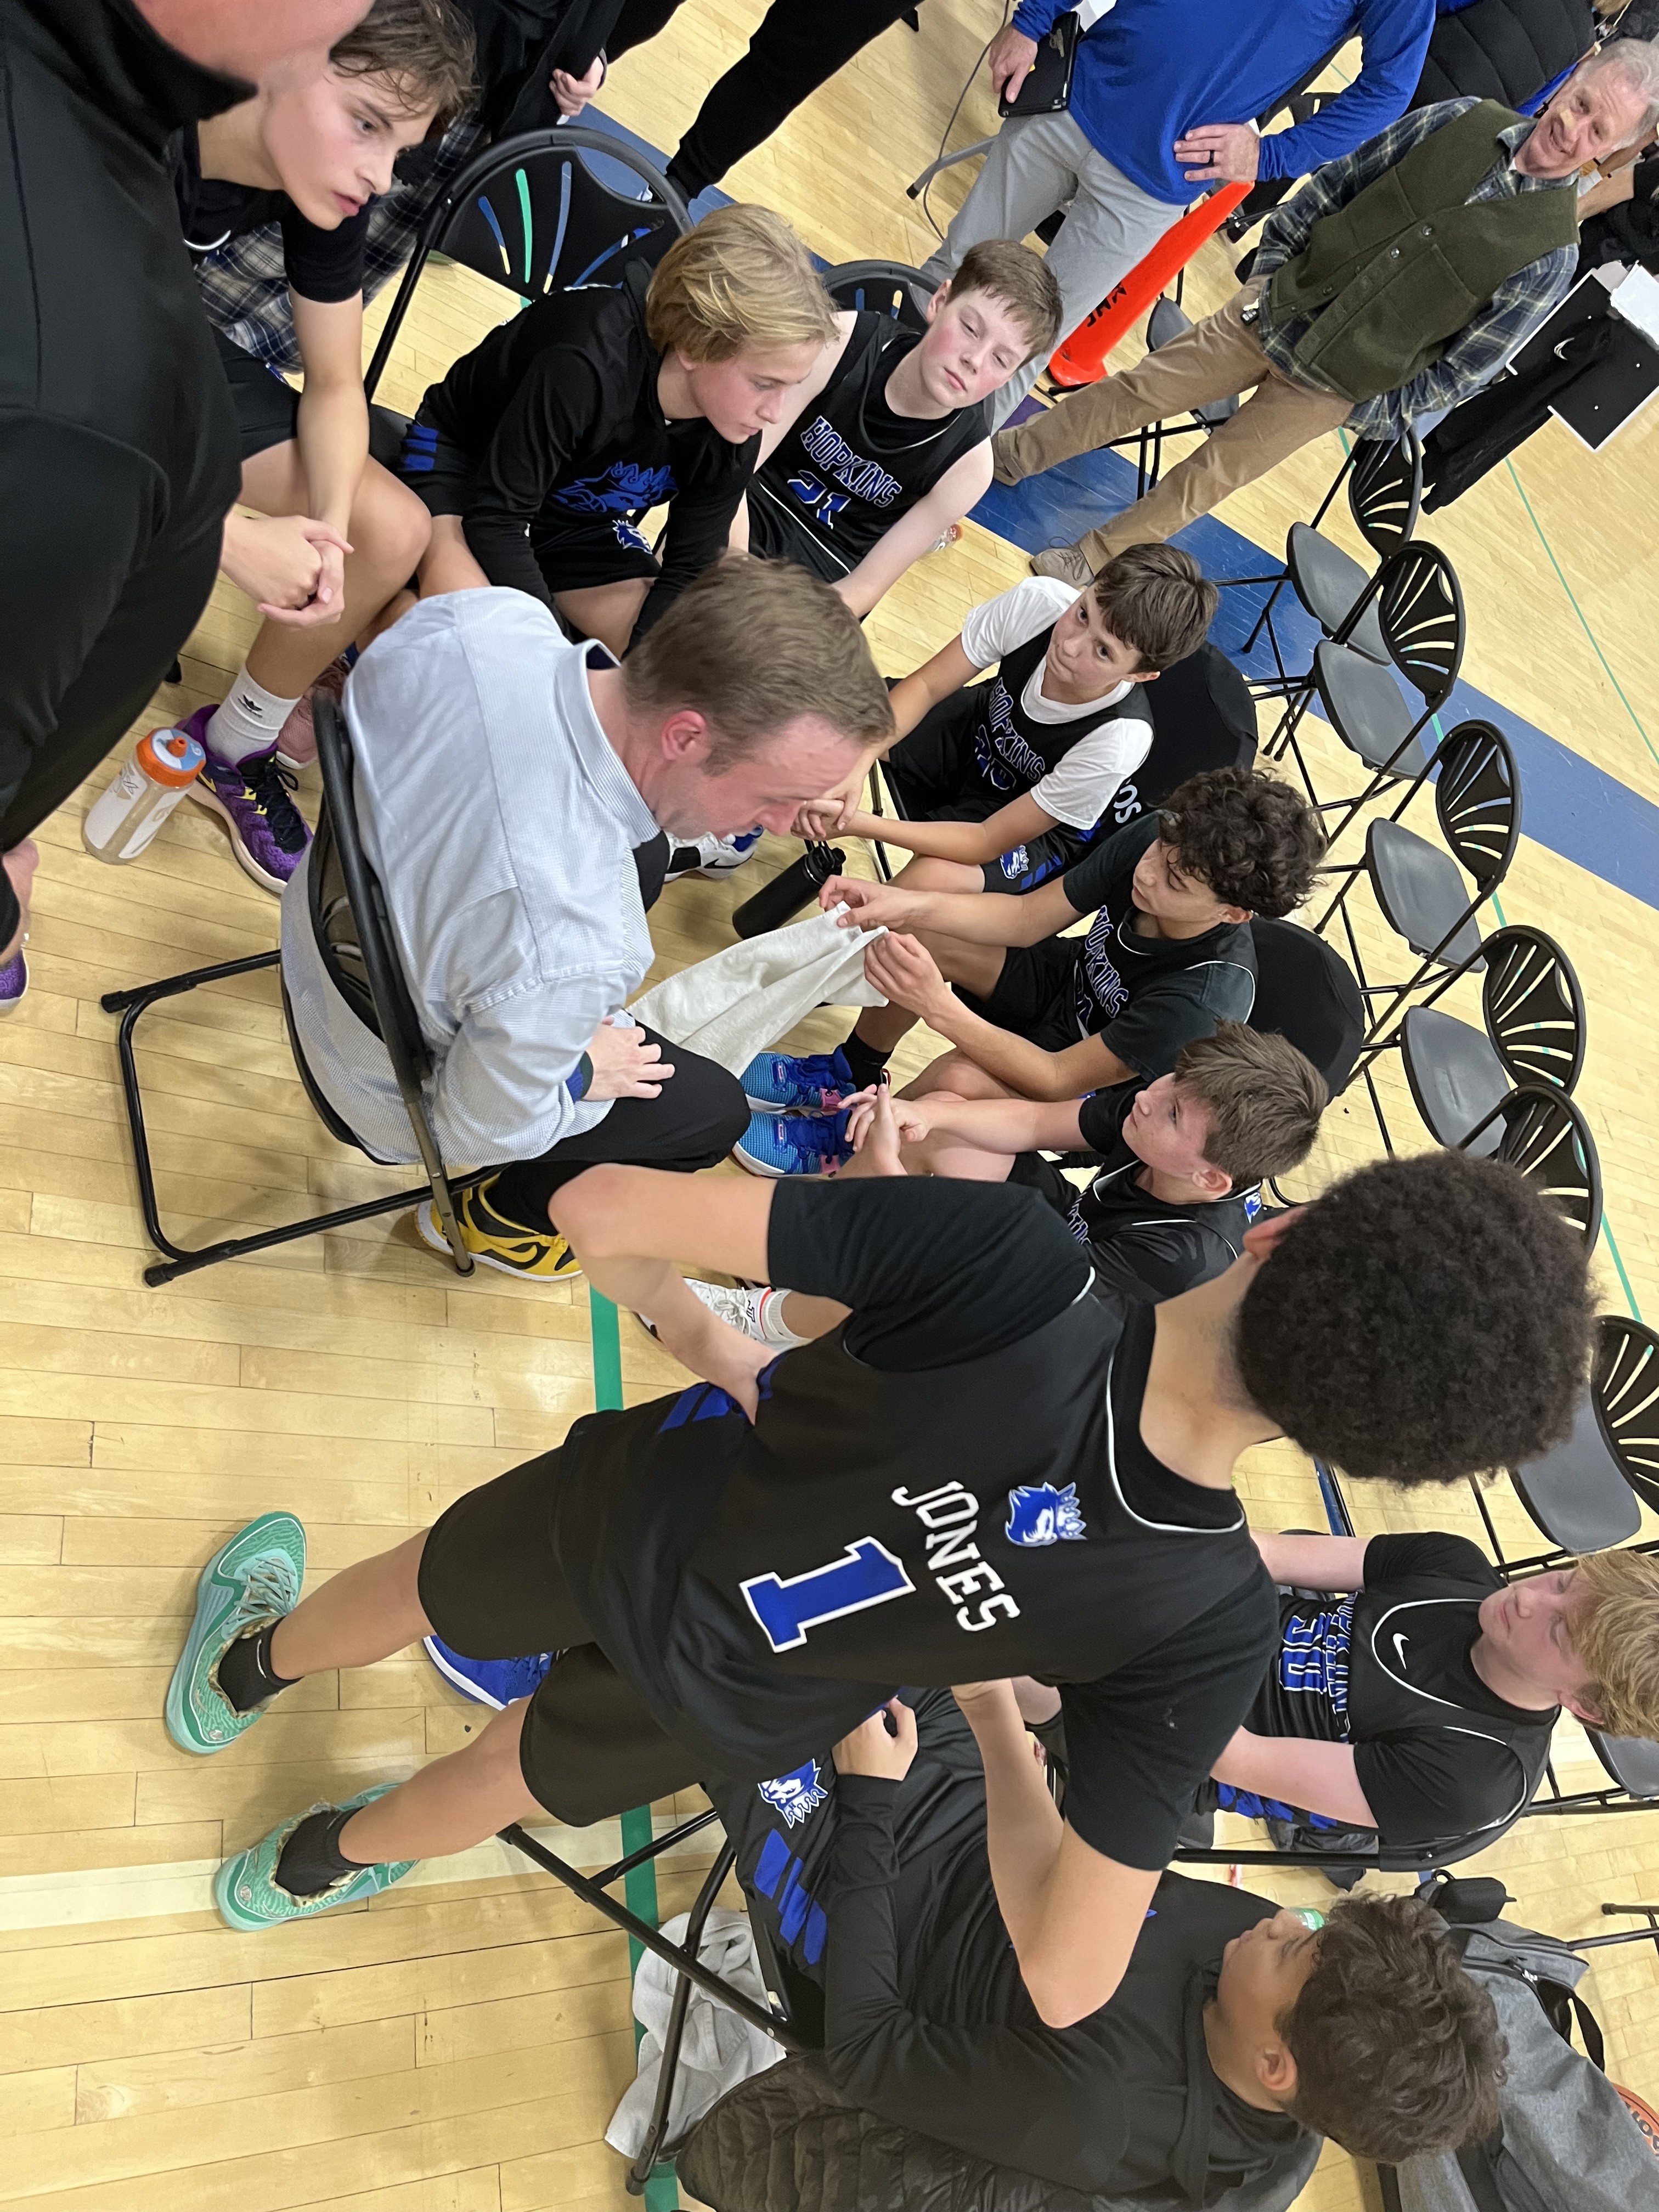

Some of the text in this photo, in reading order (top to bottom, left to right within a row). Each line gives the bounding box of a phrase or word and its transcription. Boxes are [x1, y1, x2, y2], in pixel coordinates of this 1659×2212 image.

[800, 415, 902, 508] HOPKINS
[739, 1535, 917, 1654] 1
[891, 1481, 1020, 1632] JONES
